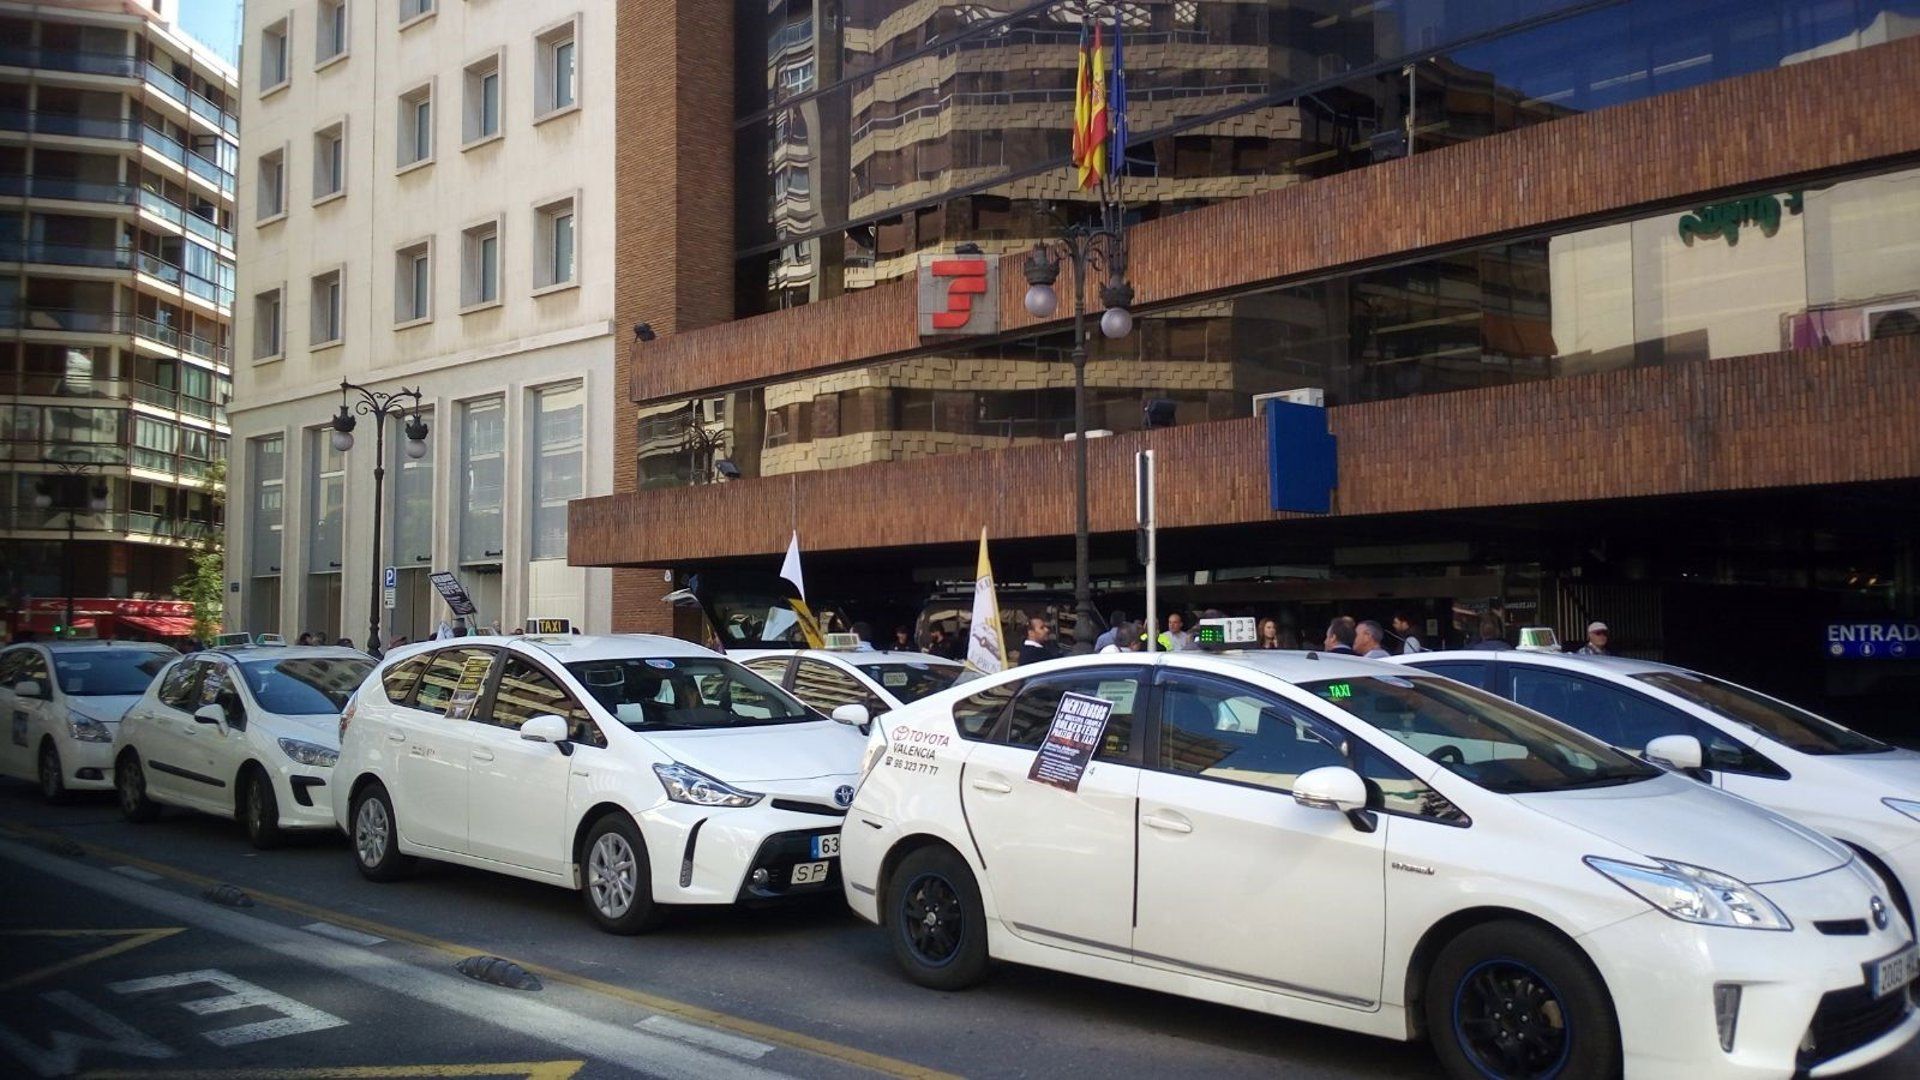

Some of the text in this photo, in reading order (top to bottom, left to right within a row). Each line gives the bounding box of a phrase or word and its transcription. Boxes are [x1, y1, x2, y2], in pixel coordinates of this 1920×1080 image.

[540, 620, 561, 633] TAXI
[1329, 684, 1351, 698] TAXI
[910, 730, 950, 747] TOYOTA
[894, 743, 936, 760] VALENCIA
